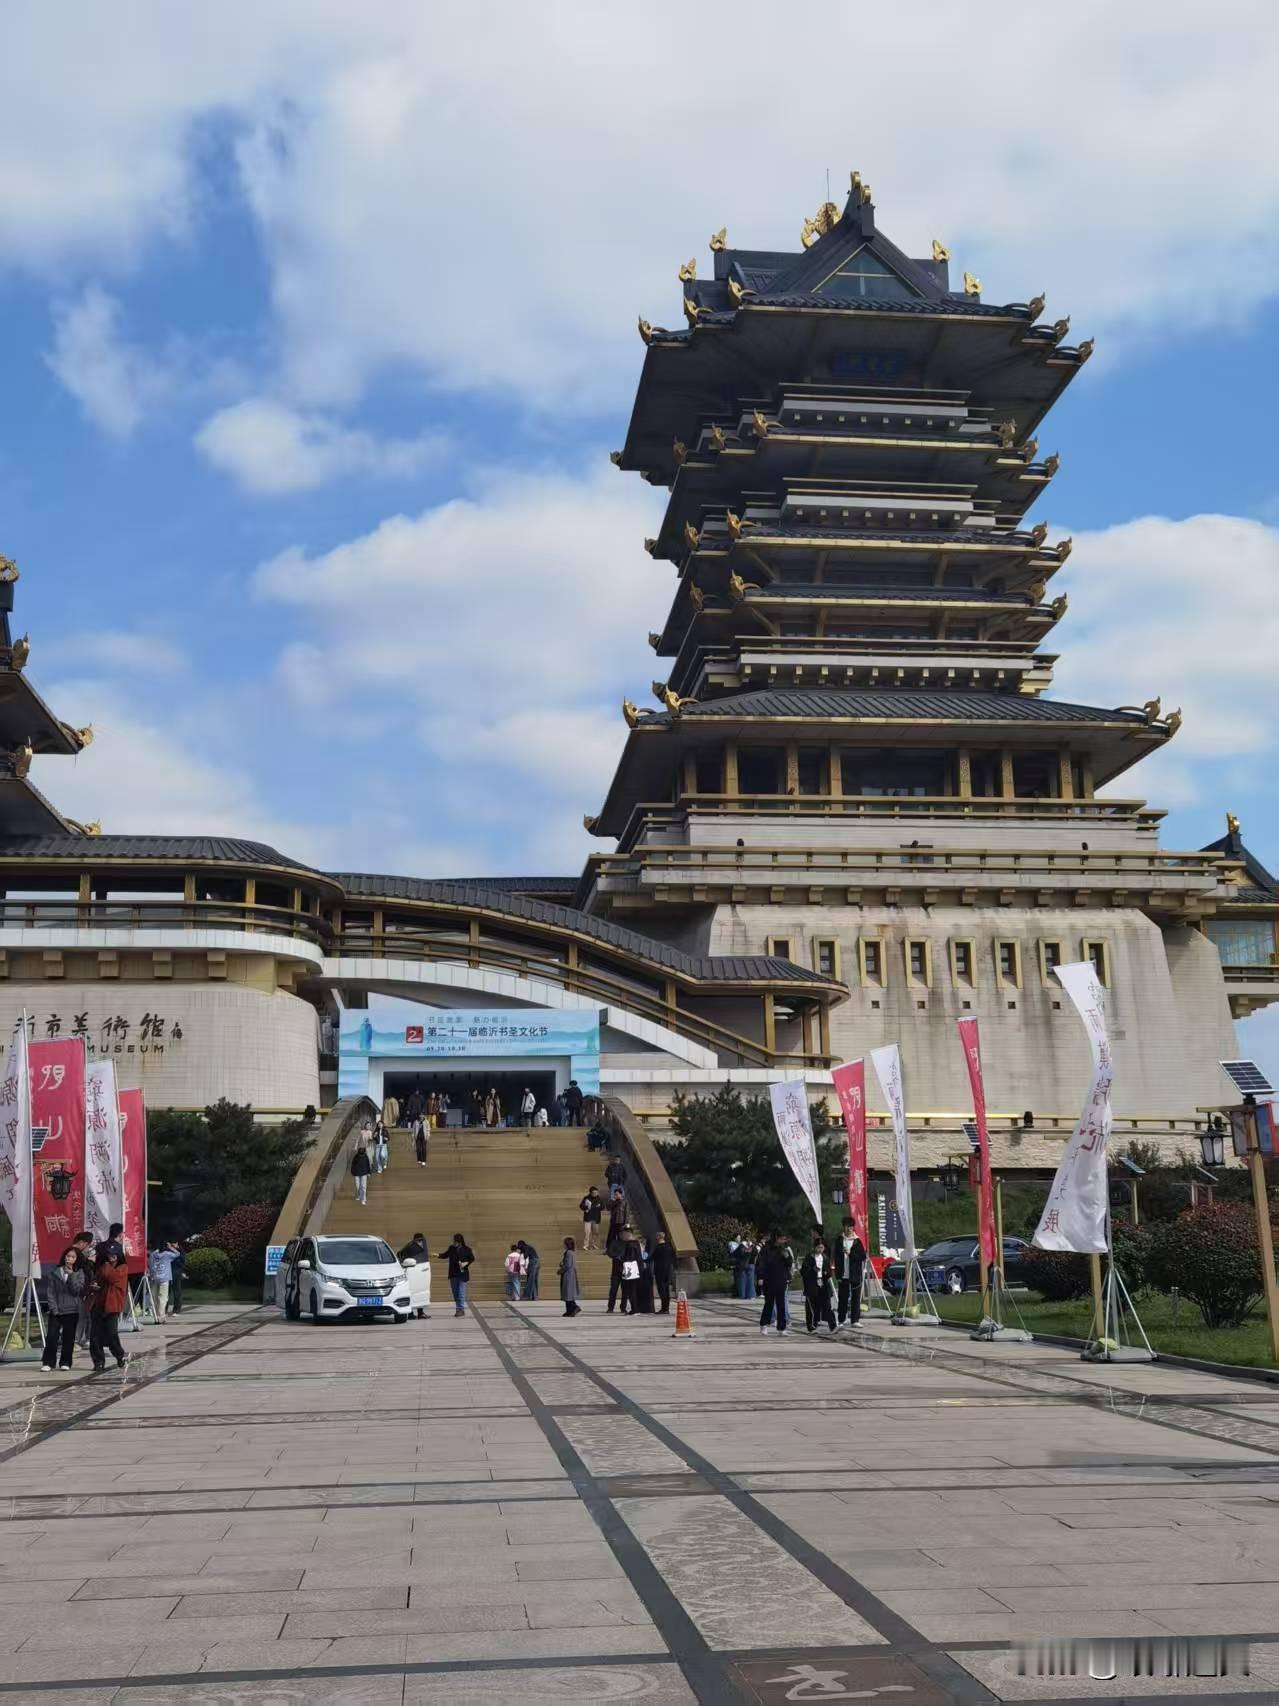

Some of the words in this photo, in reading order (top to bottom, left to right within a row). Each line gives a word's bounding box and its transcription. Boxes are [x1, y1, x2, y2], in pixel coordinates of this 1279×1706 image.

[427, 1026, 549, 1037] 第二十一届临沂书圣文化节
[87, 1045, 164, 1053] MUSEUM
